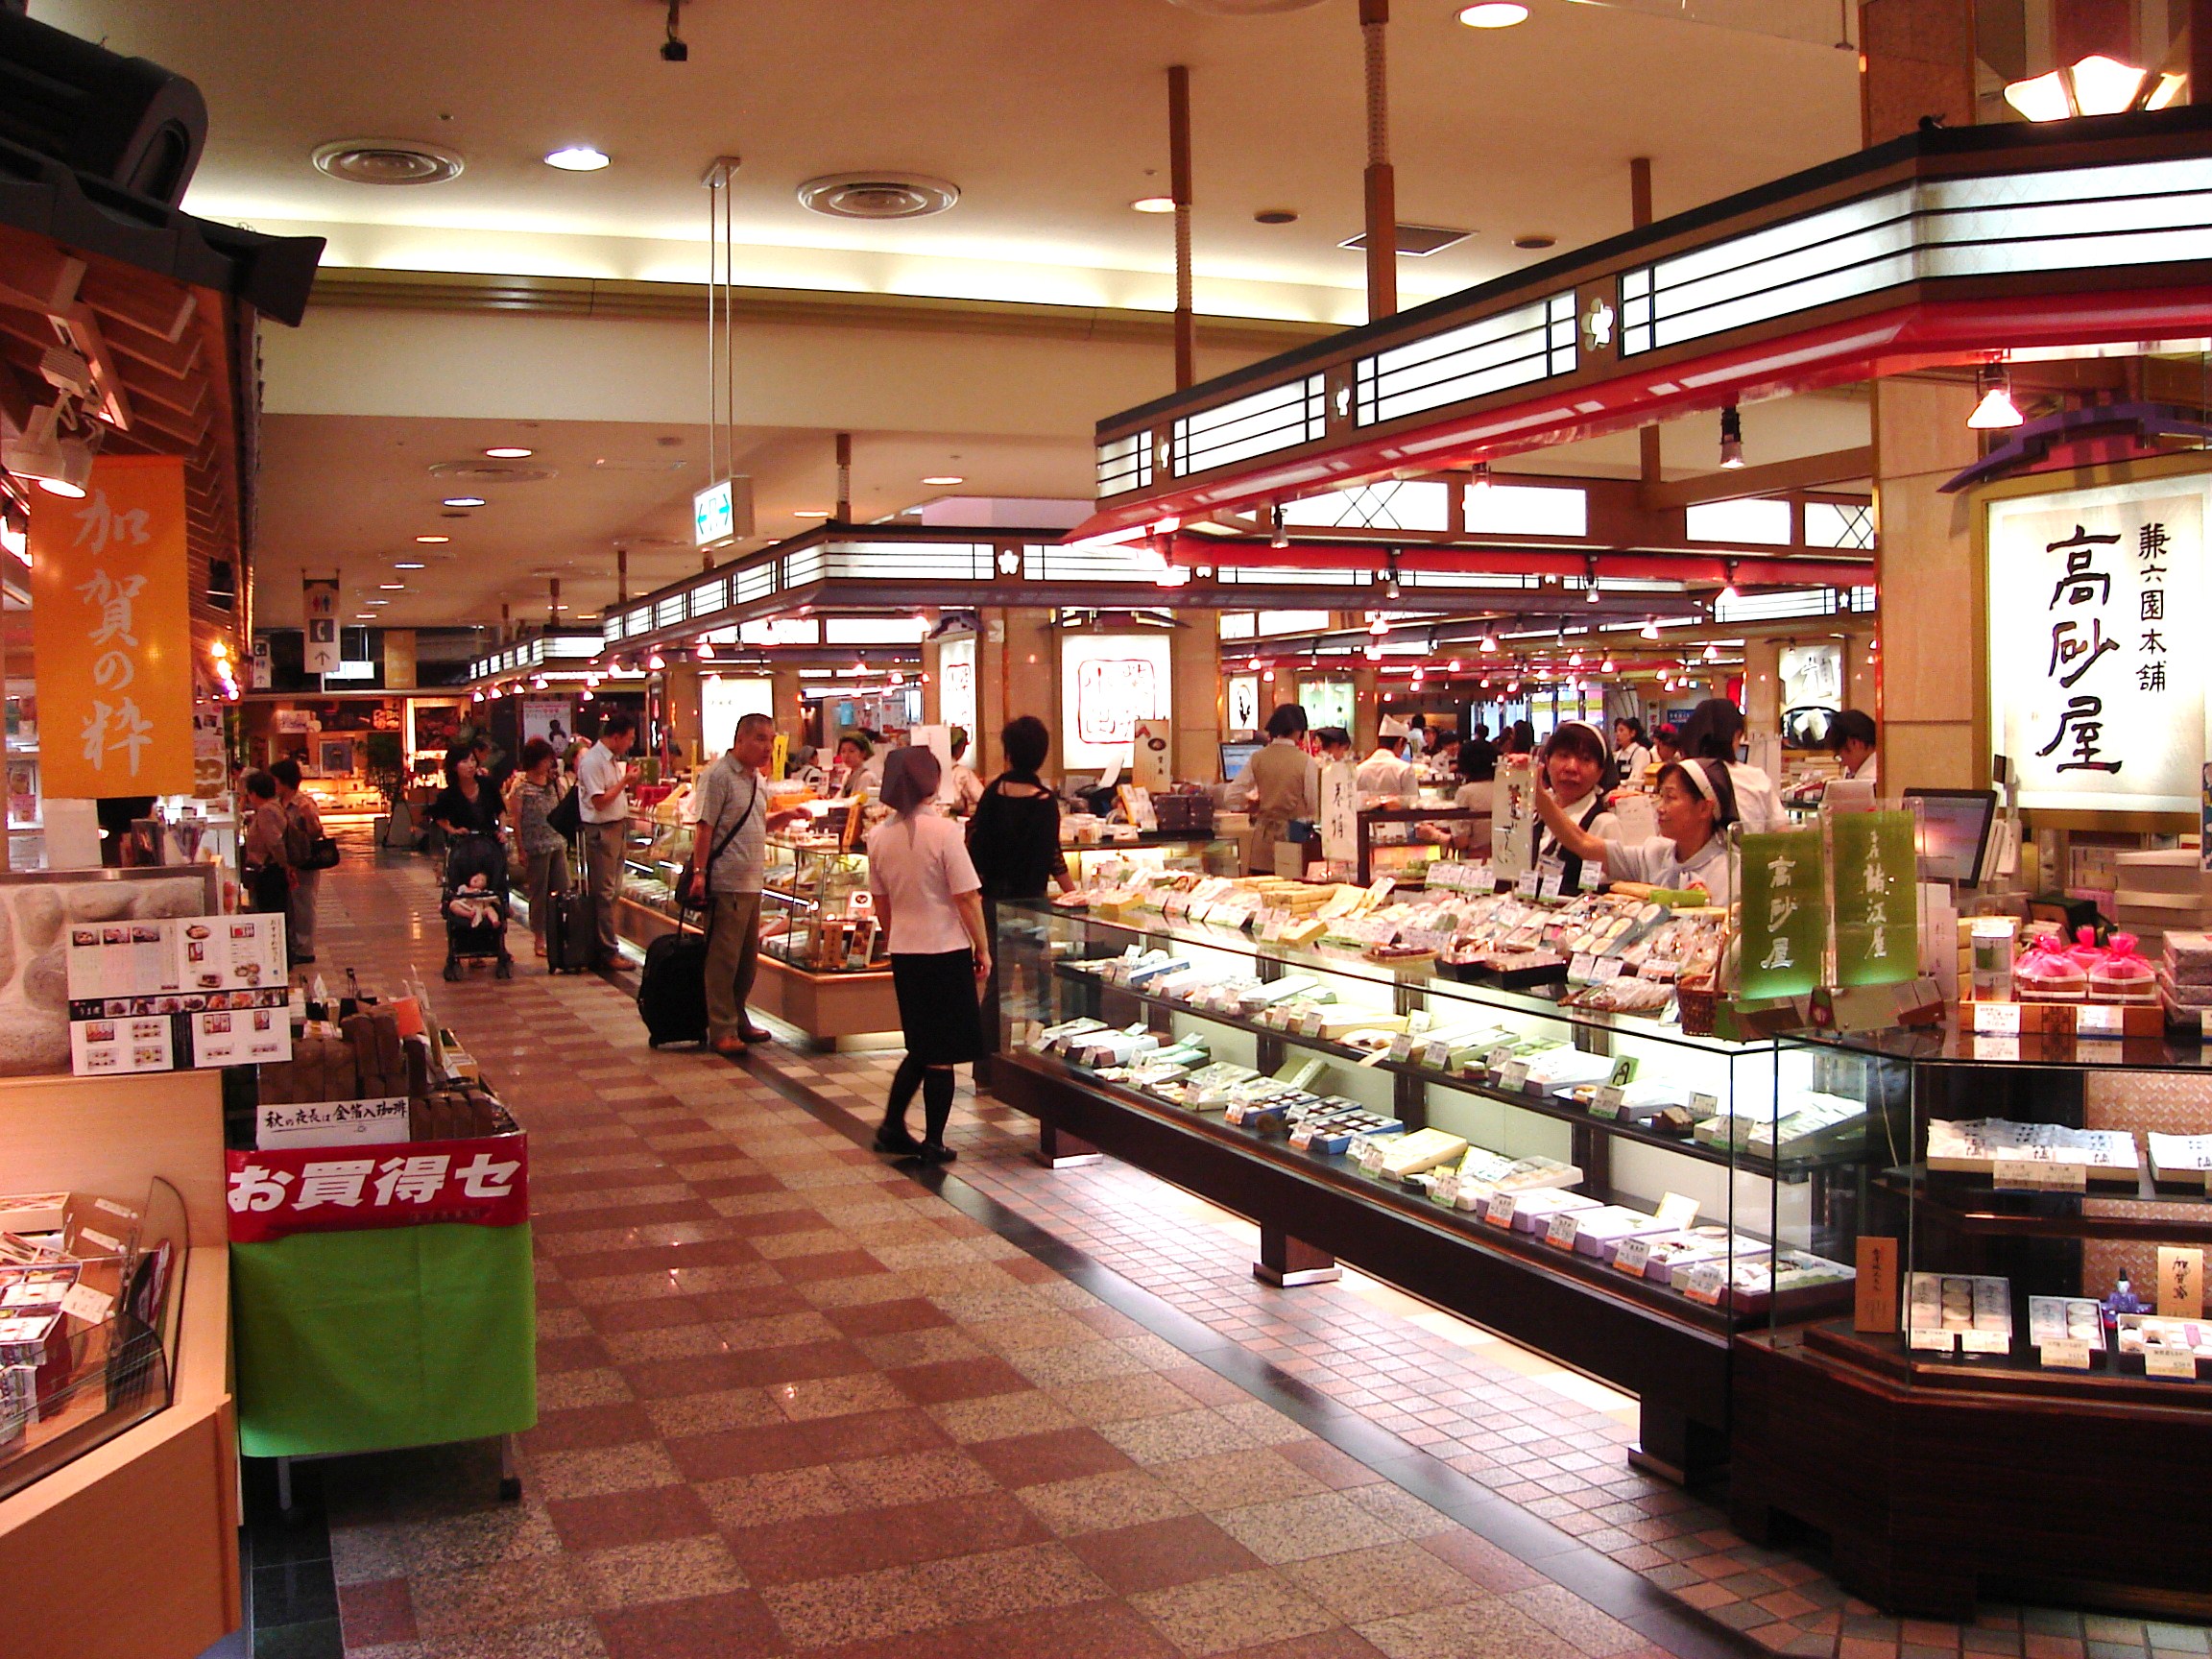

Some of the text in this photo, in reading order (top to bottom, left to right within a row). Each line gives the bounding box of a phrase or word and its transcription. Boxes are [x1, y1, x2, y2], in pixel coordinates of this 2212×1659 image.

[72, 488, 155, 777] 加賀の粋
[2035, 523, 2124, 775] 高砂屋
